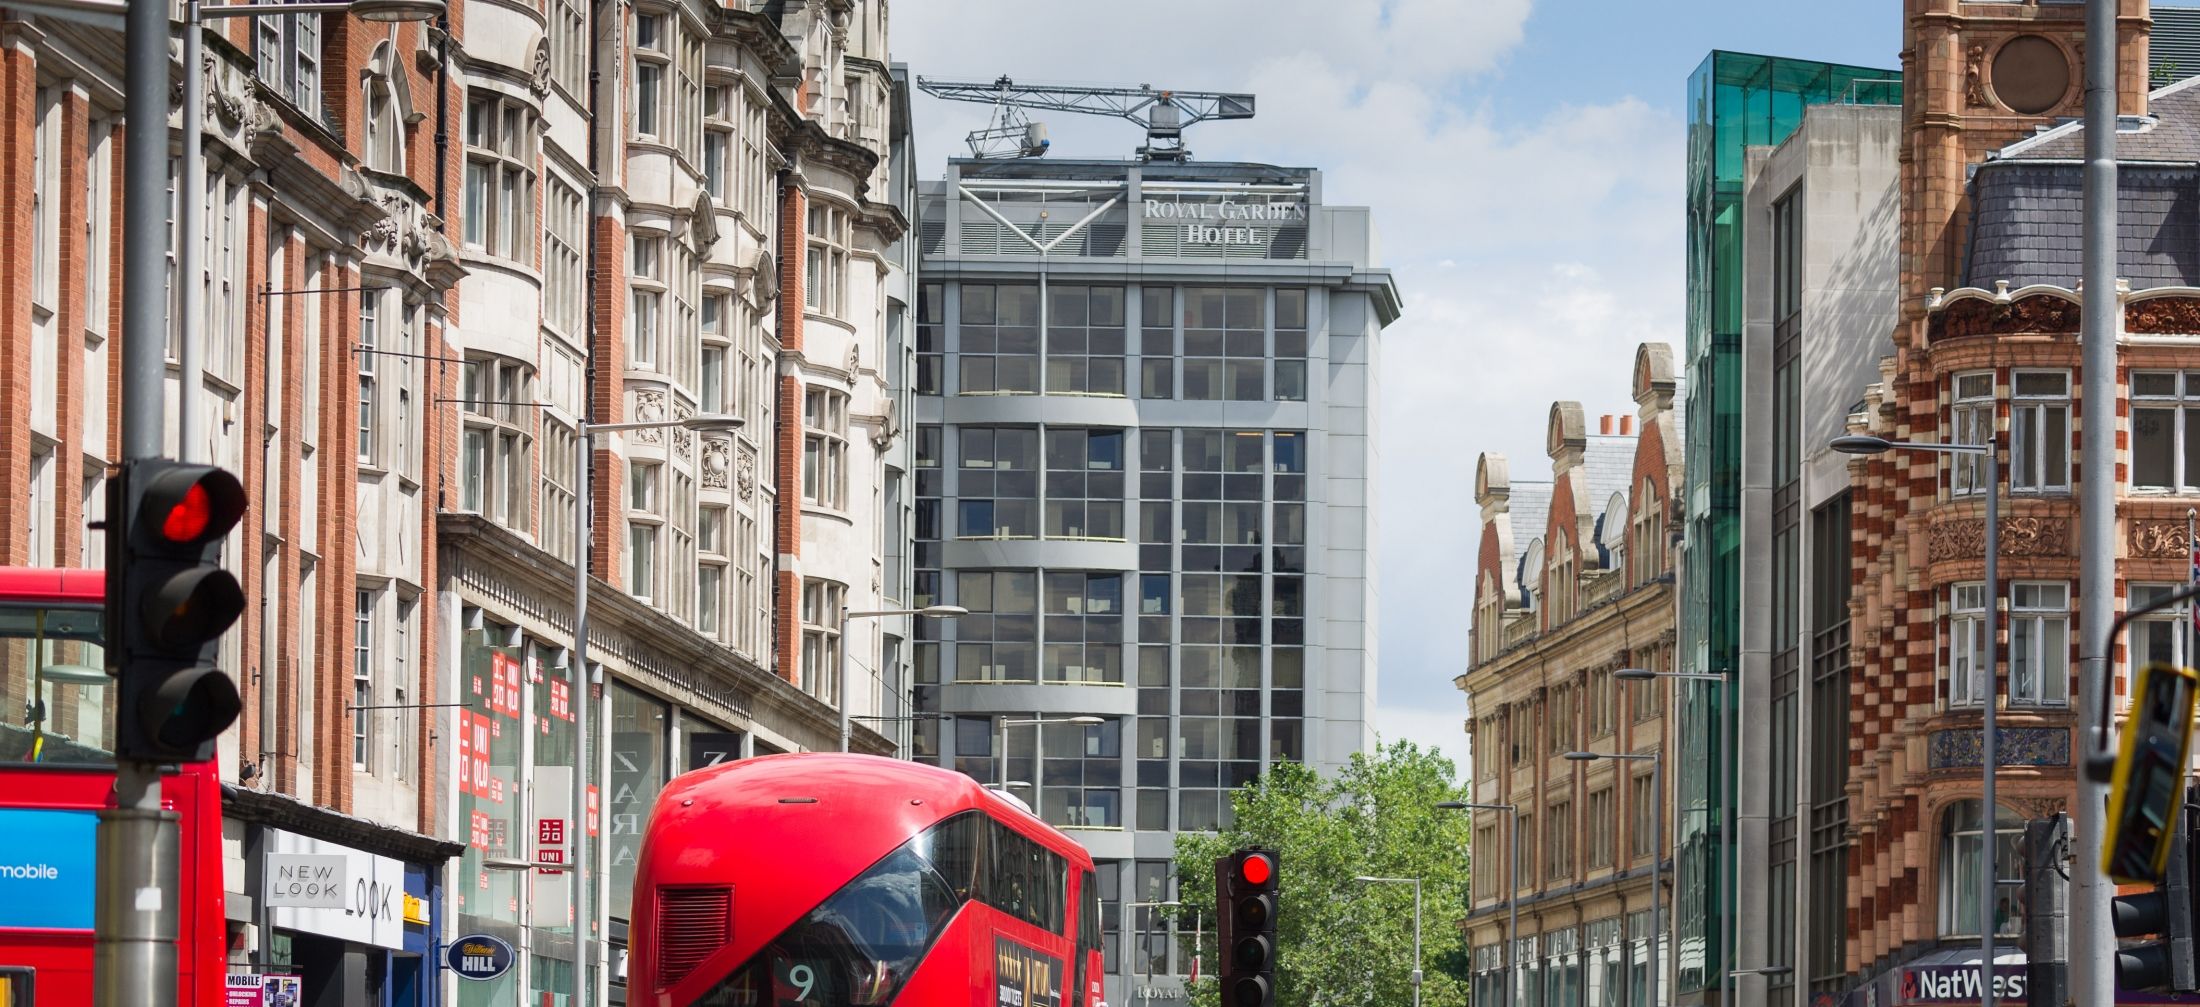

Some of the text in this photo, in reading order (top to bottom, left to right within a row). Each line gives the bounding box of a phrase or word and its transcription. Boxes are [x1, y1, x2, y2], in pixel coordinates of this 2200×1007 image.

[1144, 199, 1307, 220] ROYAL GARDEN
[1186, 224, 1261, 244] HOTEL
[474, 723, 488, 756] UNI
[473, 758, 488, 791] QLO
[541, 852, 559, 862] UNI
[280, 865, 333, 880] NEW
[274, 882, 337, 897] LOOK
[346, 877, 392, 921] OOK
[462, 956, 496, 972] HILL
[227, 975, 260, 986] MOBILE
[789, 964, 814, 1002] 9
